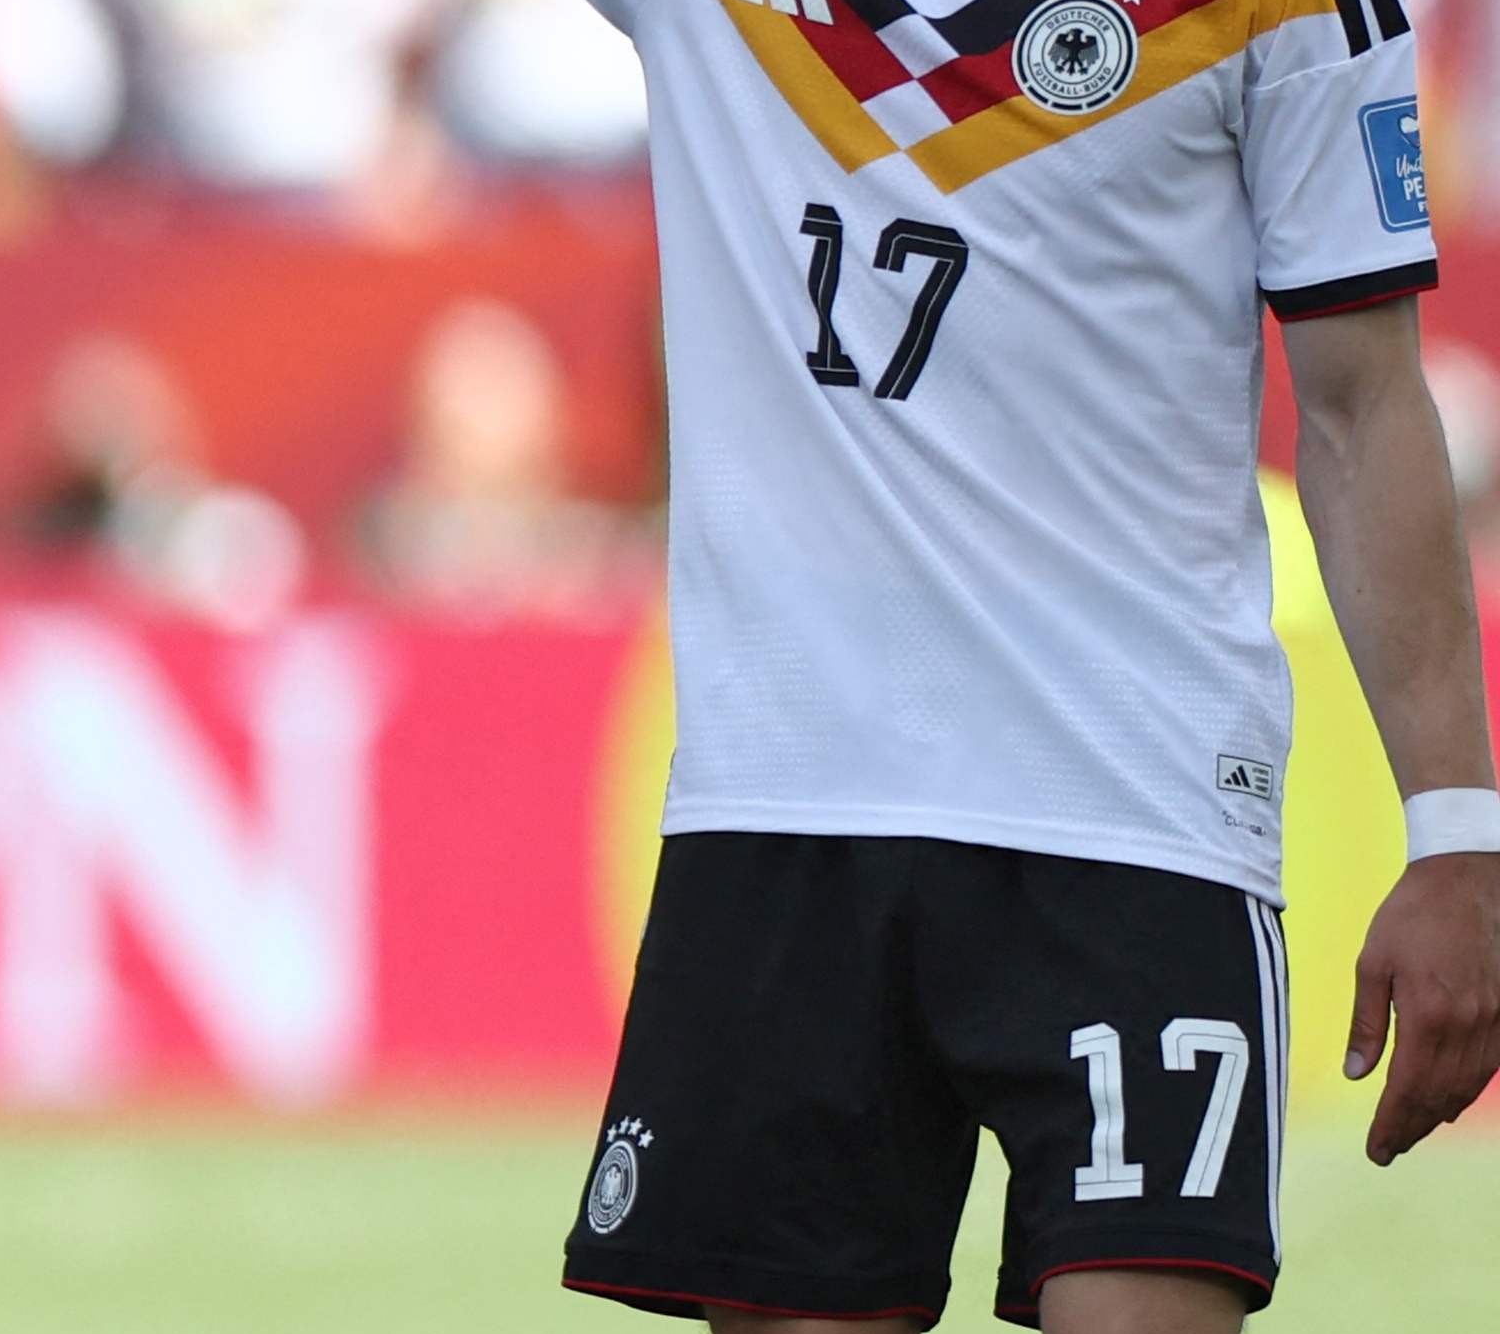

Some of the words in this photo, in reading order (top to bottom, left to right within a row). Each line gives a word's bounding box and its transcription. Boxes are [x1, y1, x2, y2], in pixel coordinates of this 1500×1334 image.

[1046, 10, 1111, 32] DEUTSCHER
[1033, 62, 1112, 95] FUSSBALL-BUND
[798, 202, 969, 401] 17
[1069, 1017, 1250, 1202] 17
